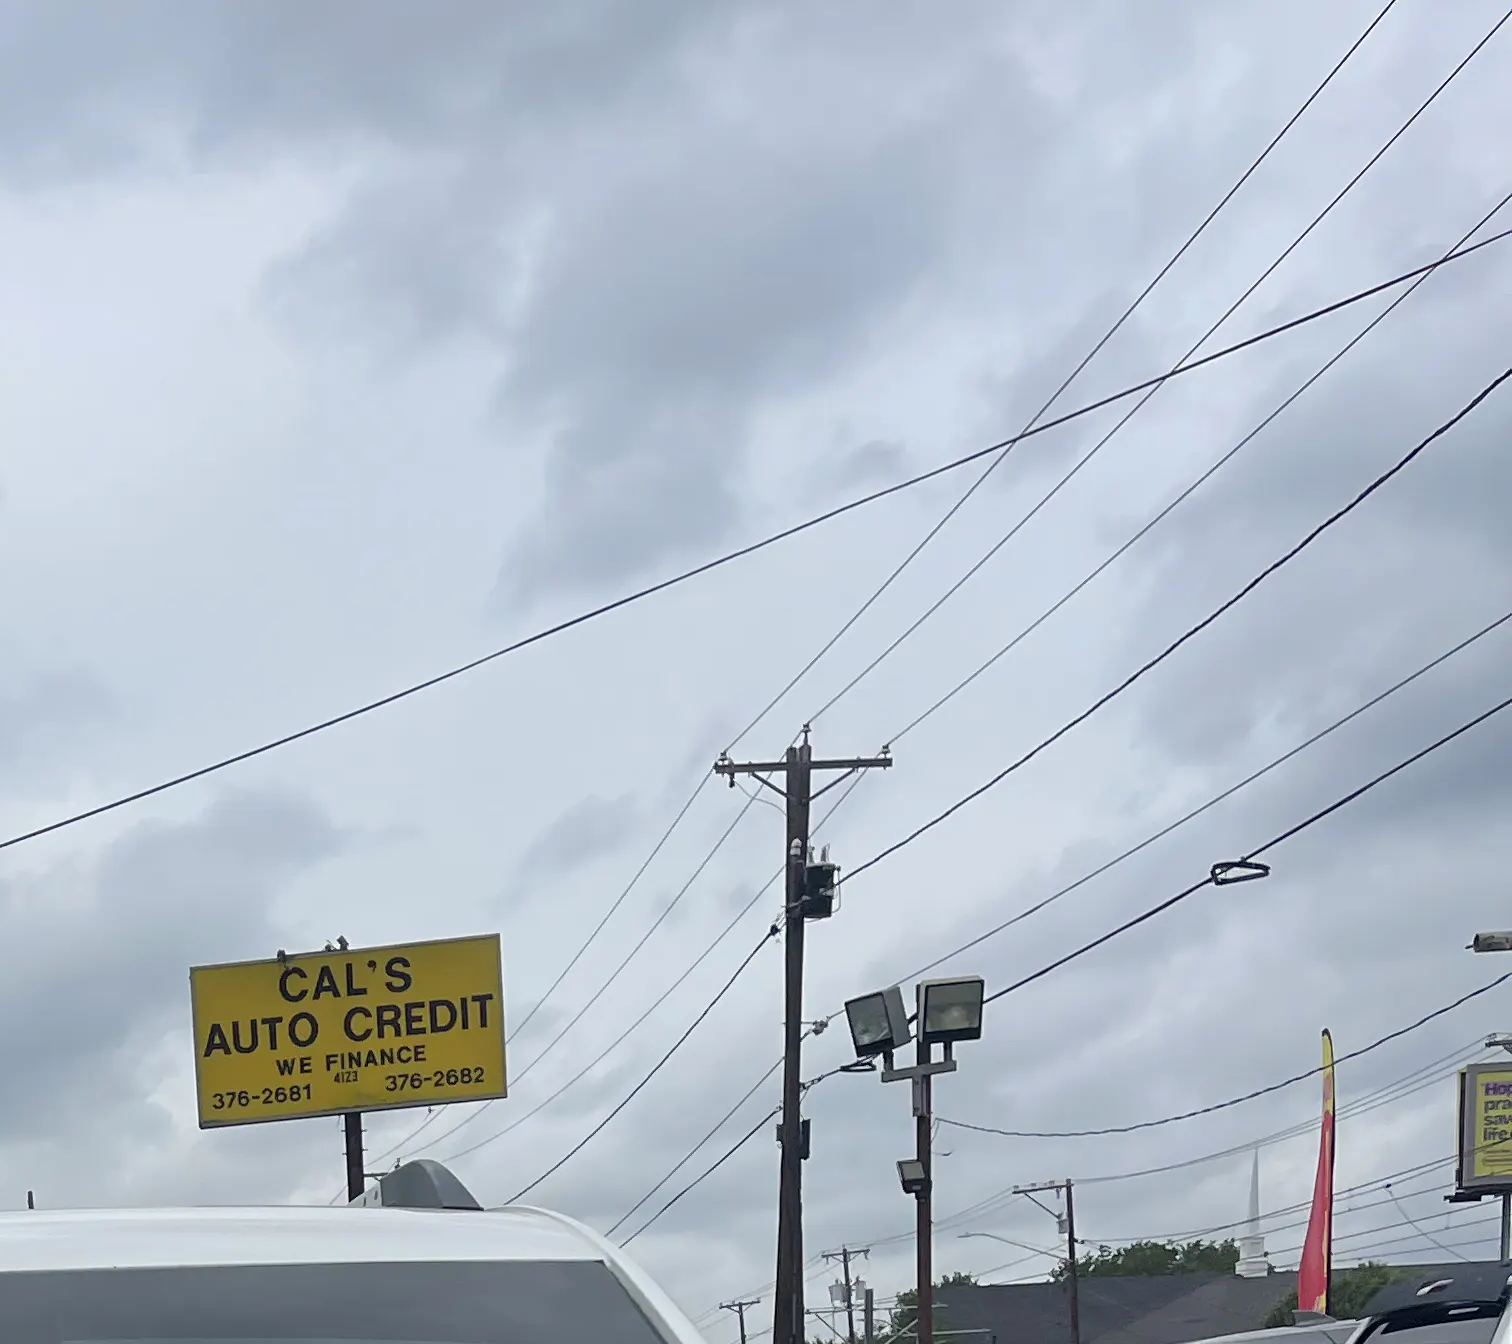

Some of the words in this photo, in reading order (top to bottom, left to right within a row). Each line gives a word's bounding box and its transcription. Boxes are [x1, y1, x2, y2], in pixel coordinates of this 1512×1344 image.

[278, 957, 412, 1002] CAL'S
[203, 1012, 319, 1057] AUTO
[343, 993, 493, 1042] CREDIT
[275, 1056, 313, 1076] WE
[325, 1045, 427, 1072] FINANCE
[333, 1070, 359, 1084] 4123
[212, 1083, 312, 1109] 376-2681
[384, 1066, 485, 1092] 376-2682
